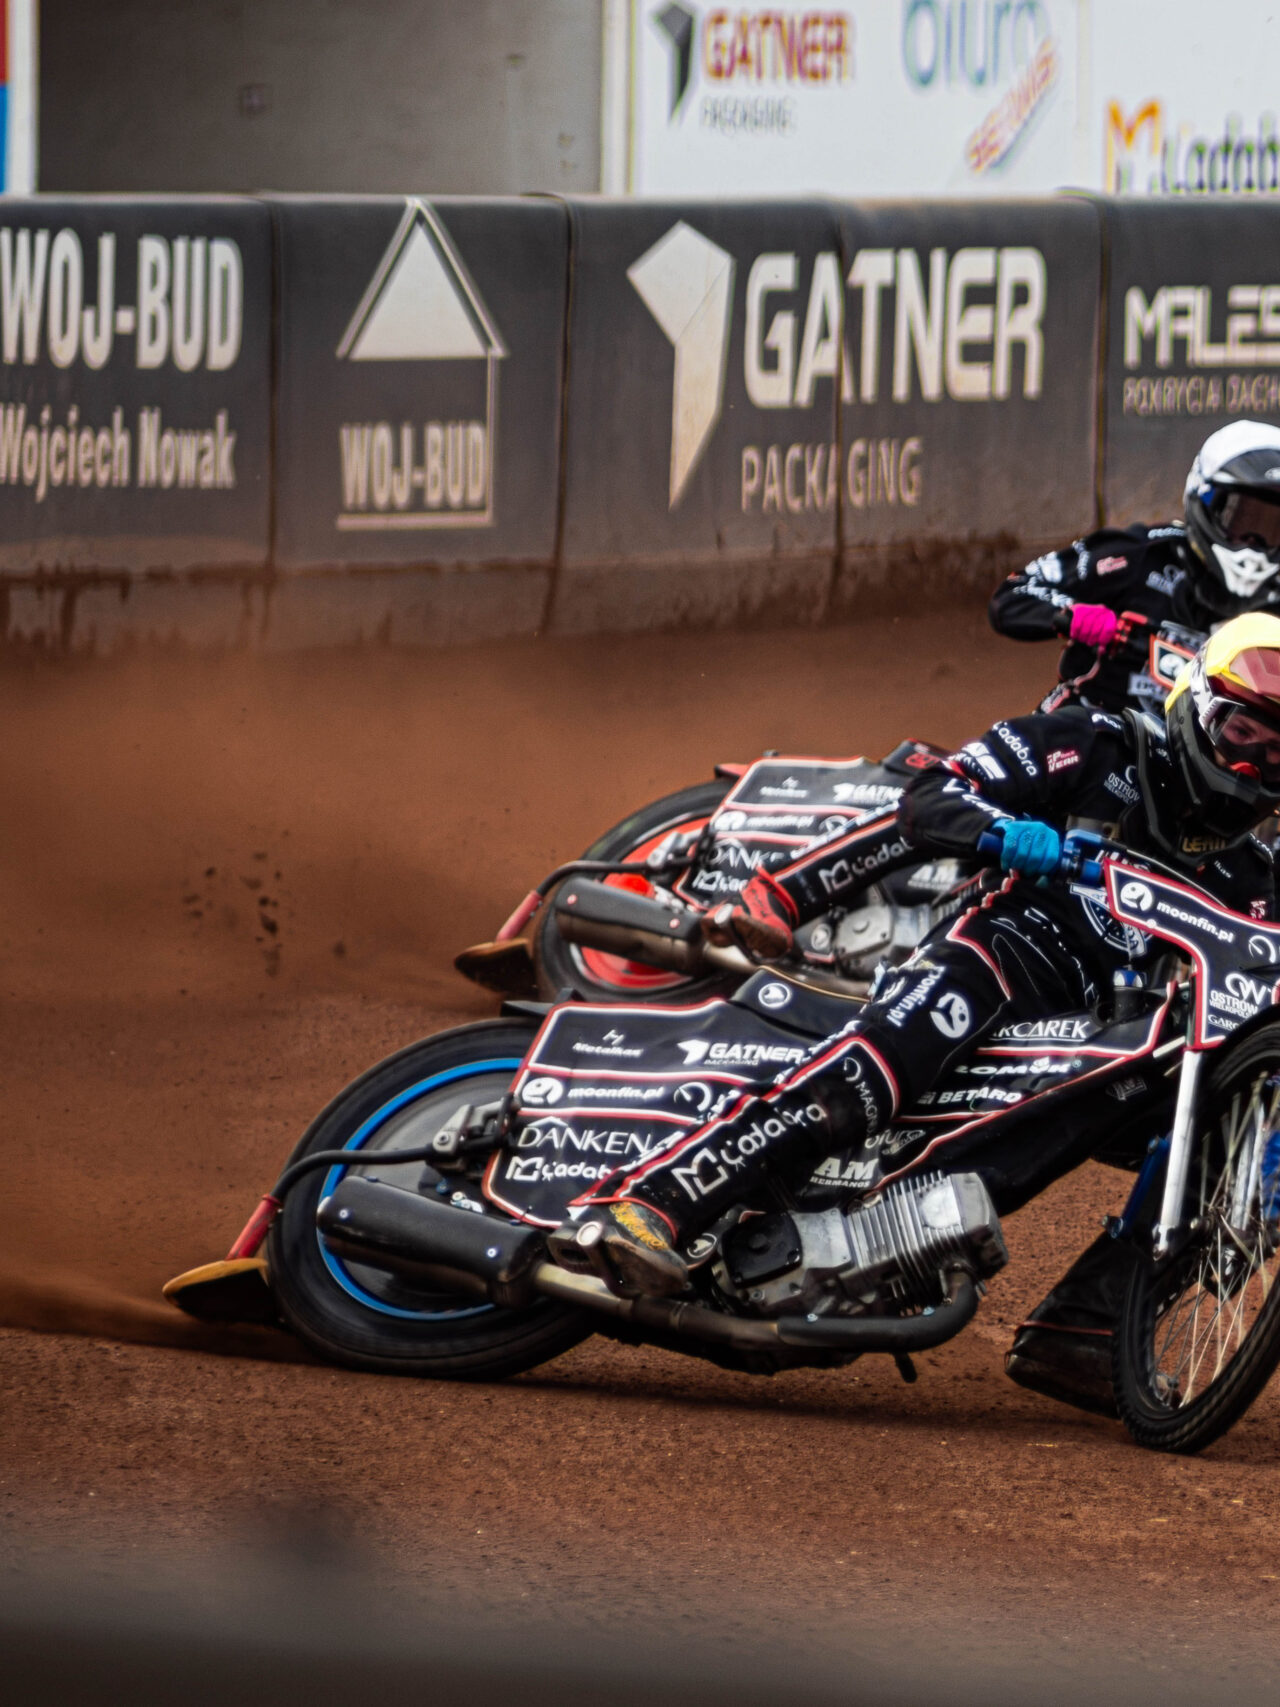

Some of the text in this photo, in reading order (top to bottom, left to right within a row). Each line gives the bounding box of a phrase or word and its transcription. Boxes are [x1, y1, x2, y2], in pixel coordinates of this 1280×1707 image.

[702, 10, 852, 84] GATNER
[0, 228, 243, 371] WOJ-BUD
[744, 246, 1047, 409] GATNER
[0, 404, 236, 502] Wojciech Nowak
[338, 420, 486, 508] WOJ-BUD
[741, 437, 923, 511] PACKAGING
[1156, 901, 1234, 943] moonfin.pl
[708, 1042, 804, 1065] GATNER
[567, 1084, 664, 1101] moonfin.pl
[937, 1086, 1022, 1104] BETARD
[809, 1176, 871, 1188] HERMANOS
[814, 1156, 879, 1180] AM
